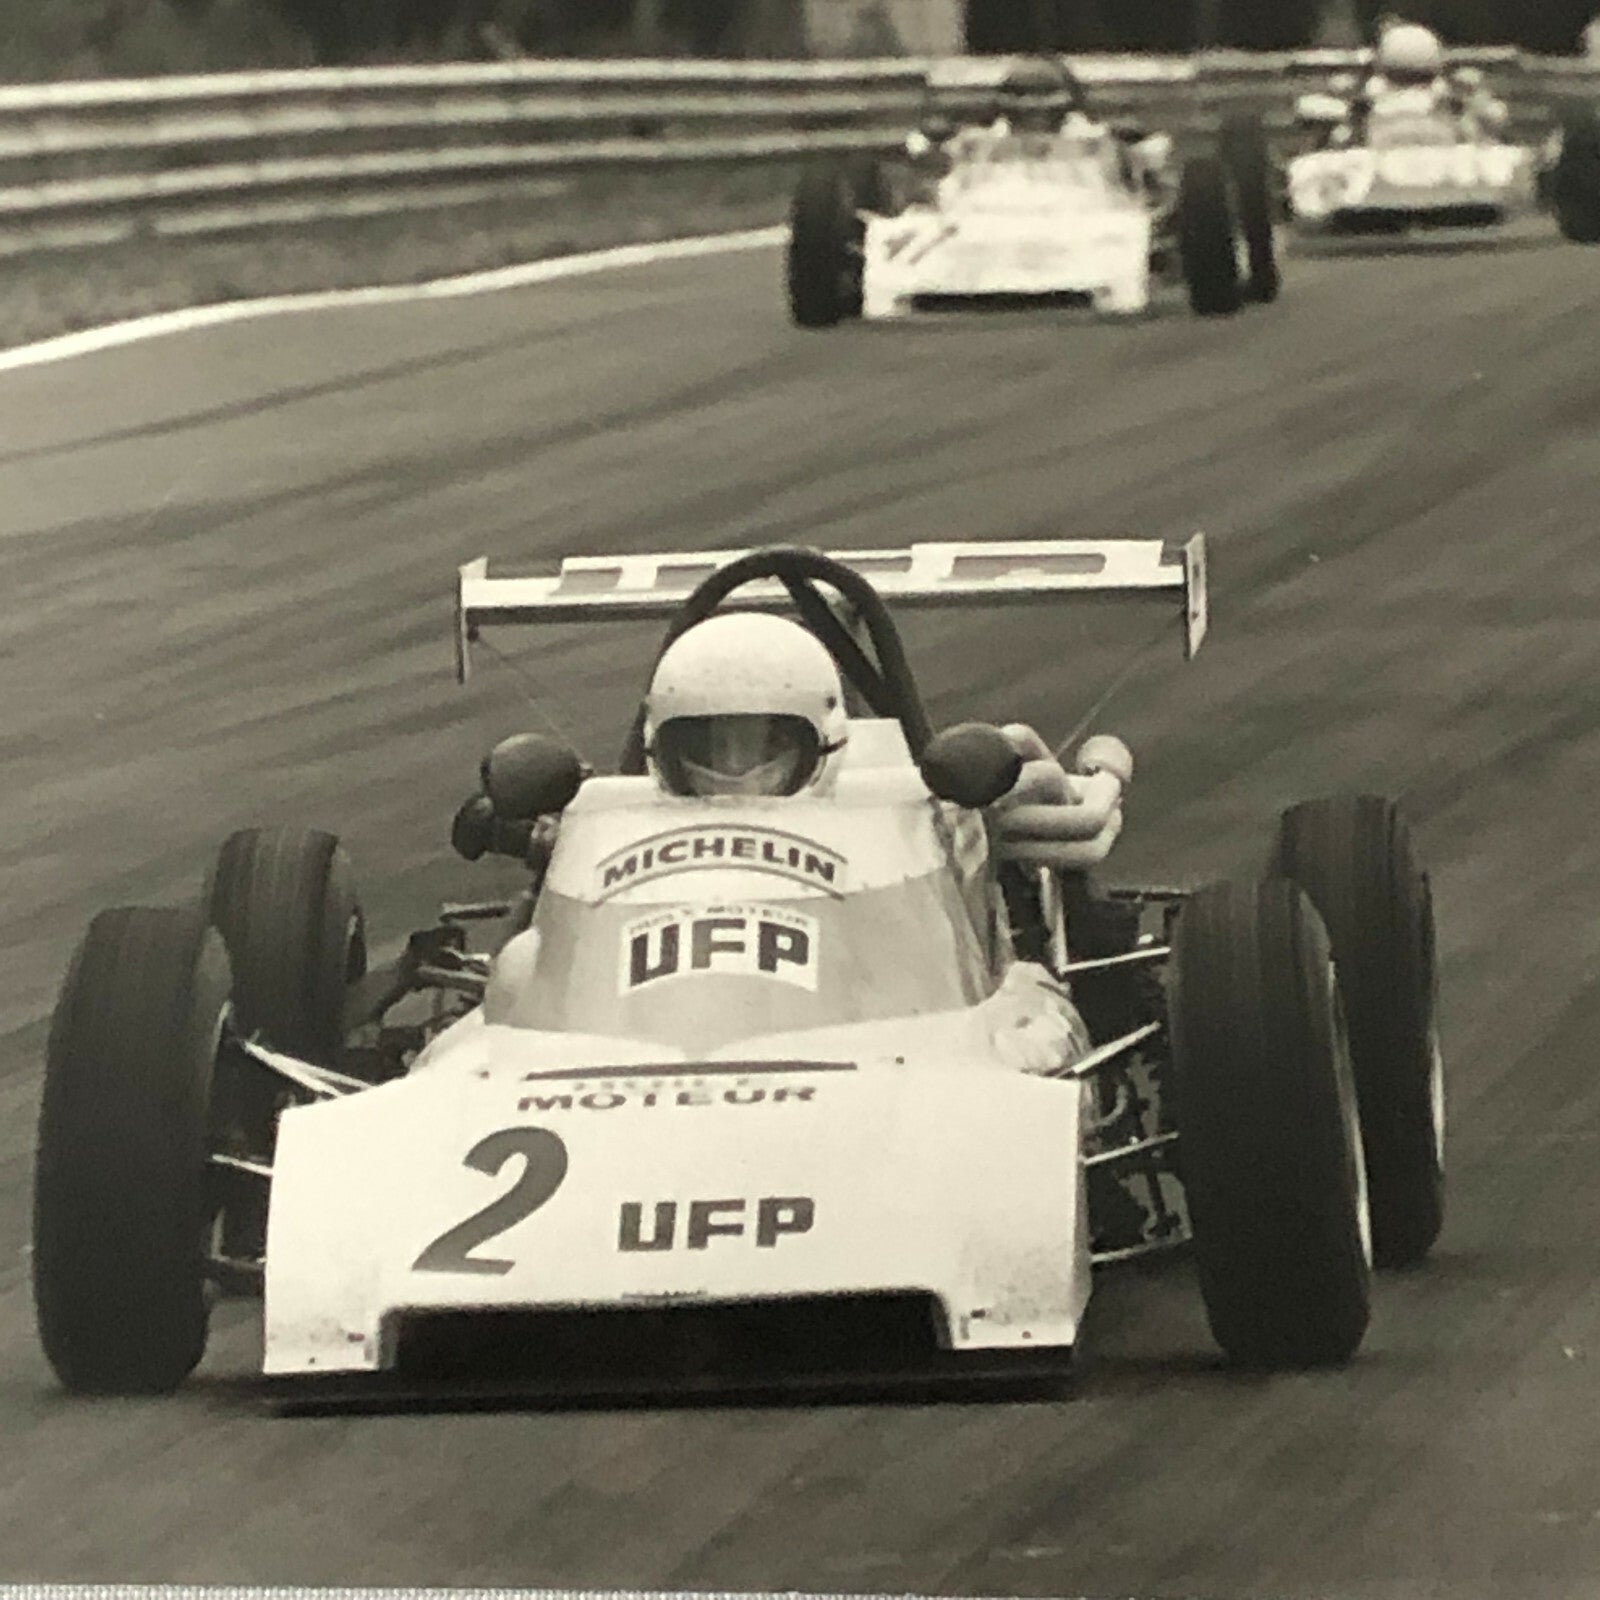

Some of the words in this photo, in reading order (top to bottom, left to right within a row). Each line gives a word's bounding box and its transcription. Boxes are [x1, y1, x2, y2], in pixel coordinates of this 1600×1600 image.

[603, 836, 836, 889] MICHELIN
[629, 917, 810, 986] UFP
[516, 1086, 816, 1112] MOTEUR
[411, 1125, 569, 1276] 2
[617, 1196, 816, 1252] UFP
